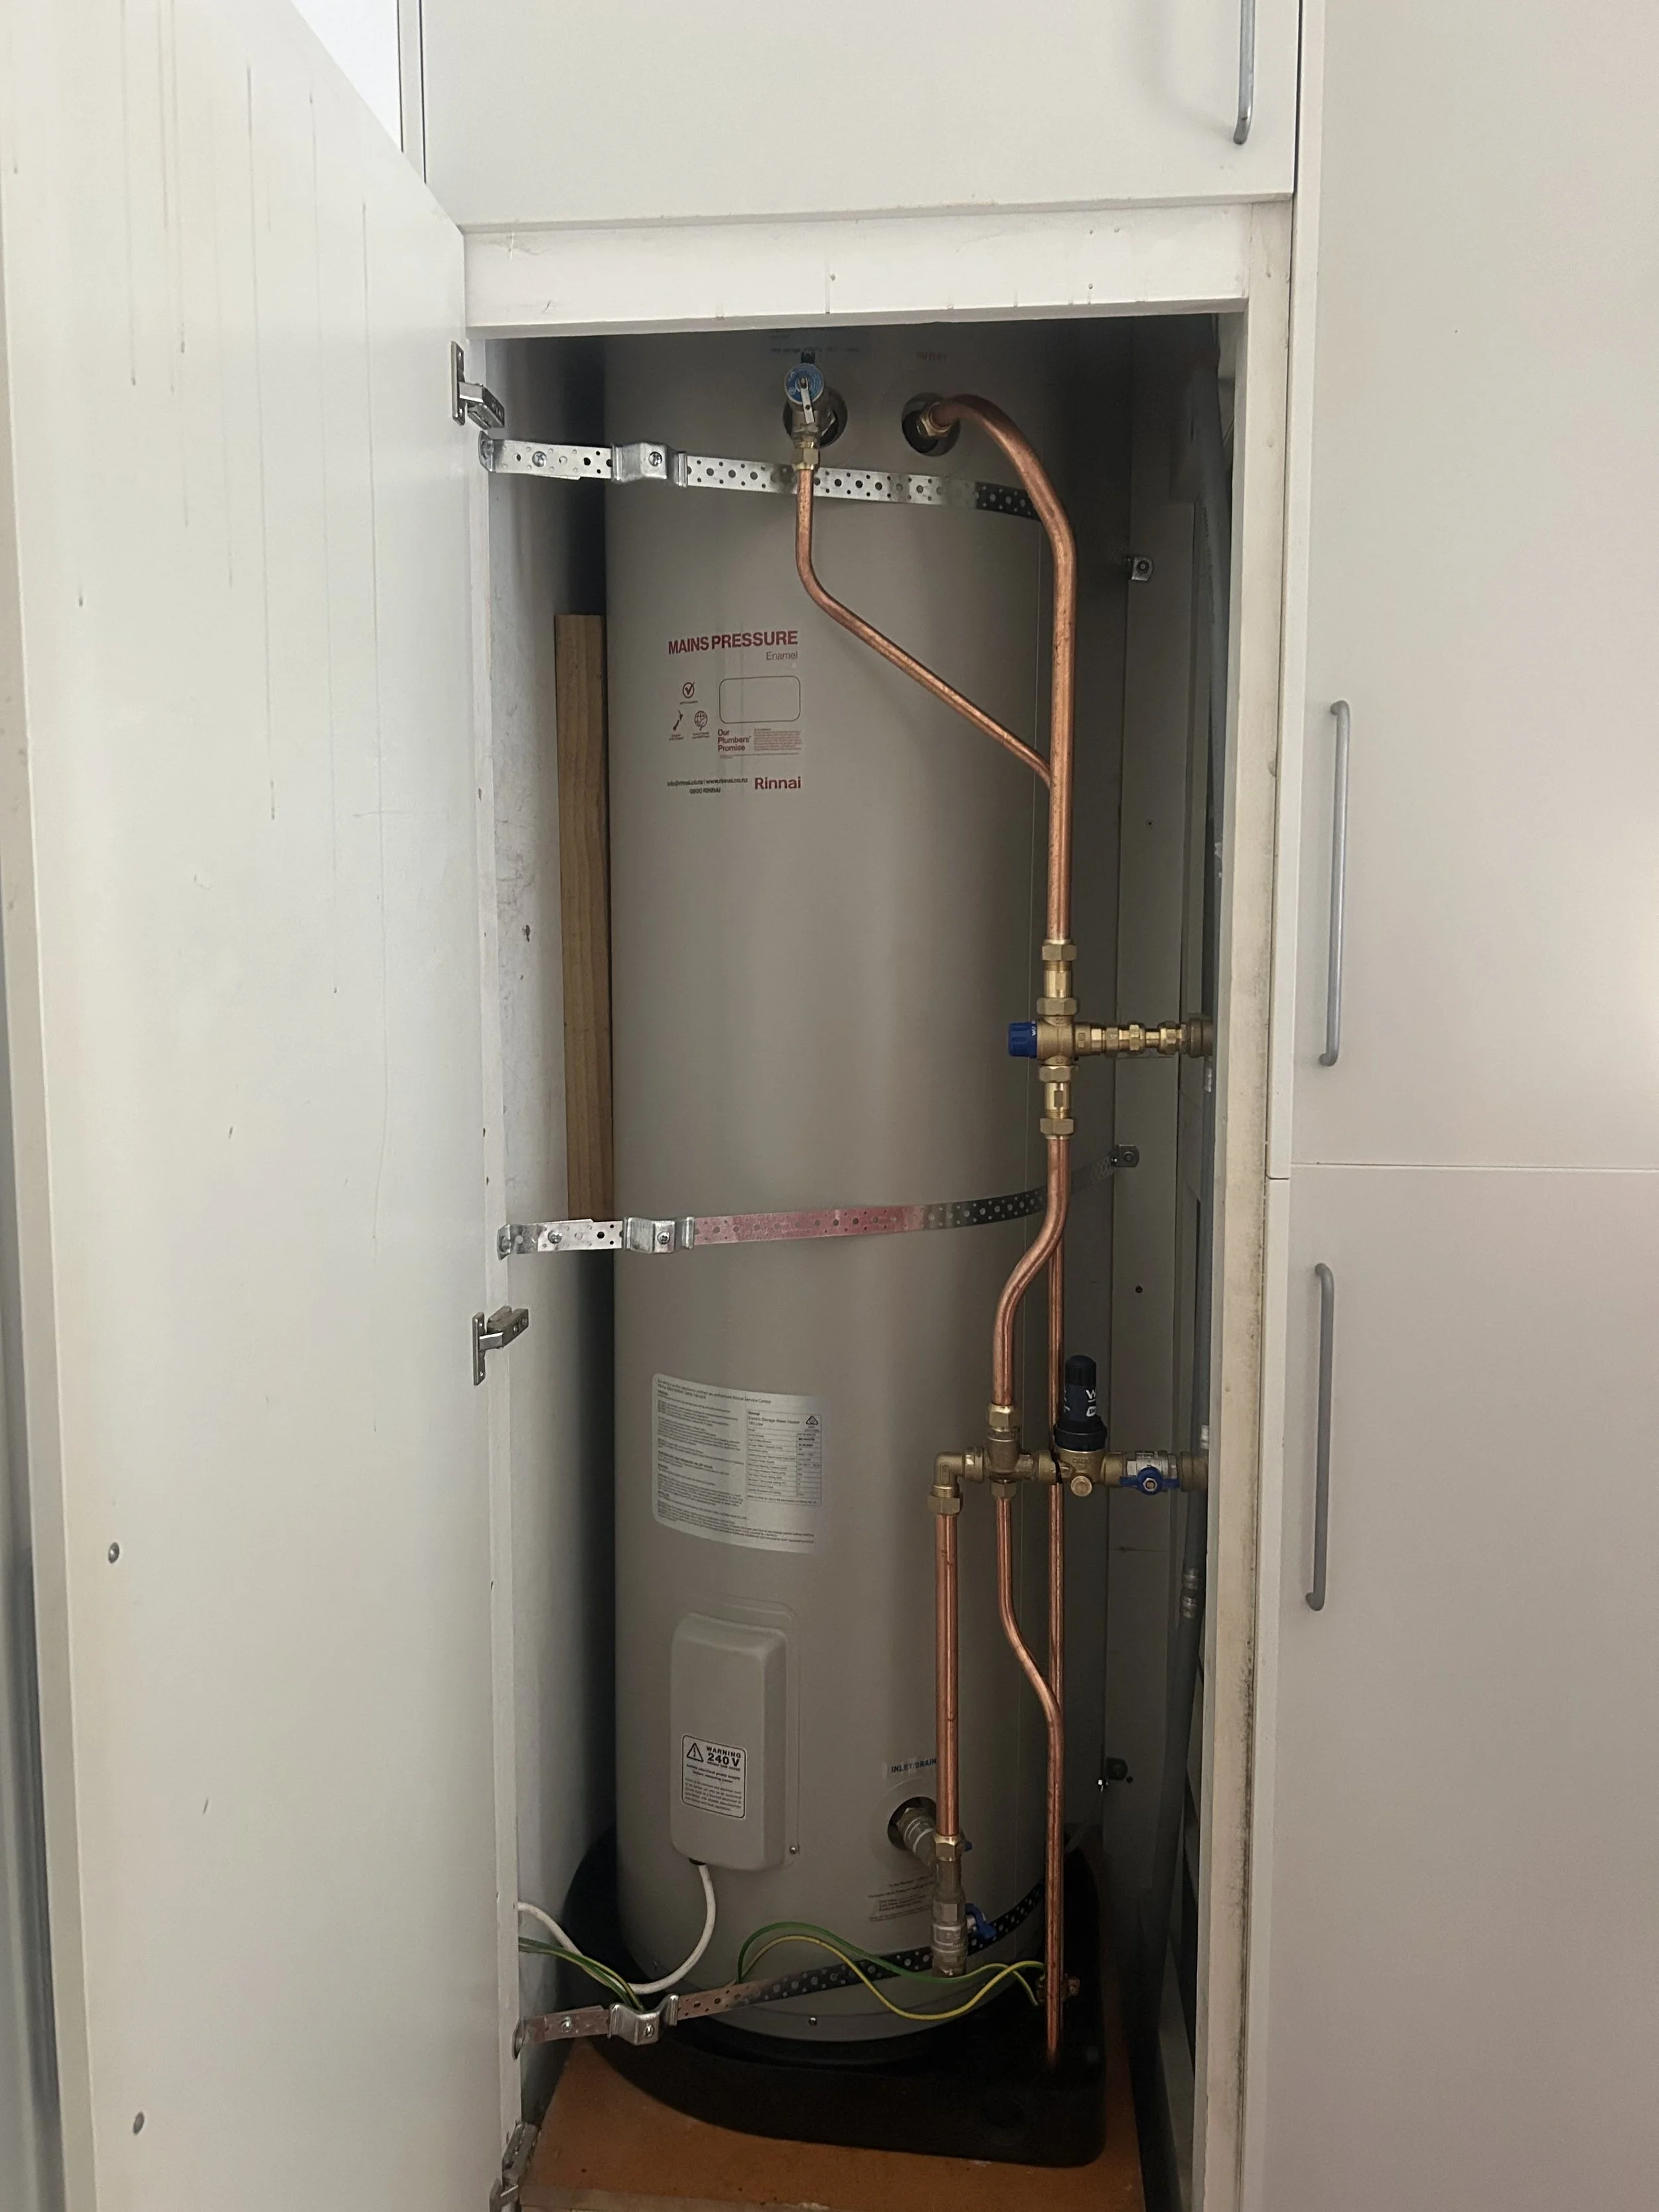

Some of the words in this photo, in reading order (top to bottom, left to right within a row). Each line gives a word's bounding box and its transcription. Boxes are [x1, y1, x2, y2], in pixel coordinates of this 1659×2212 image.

[668, 636, 709, 654] MAINS
[711, 630, 798, 650] PRESSURE
[766, 651, 798, 660] Enamel
[755, 776, 801, 790] Rinnai
[706, 1746, 741, 1758] WARNING
[708, 1753, 729, 1765] 240
[732, 1757, 739, 1767] V
